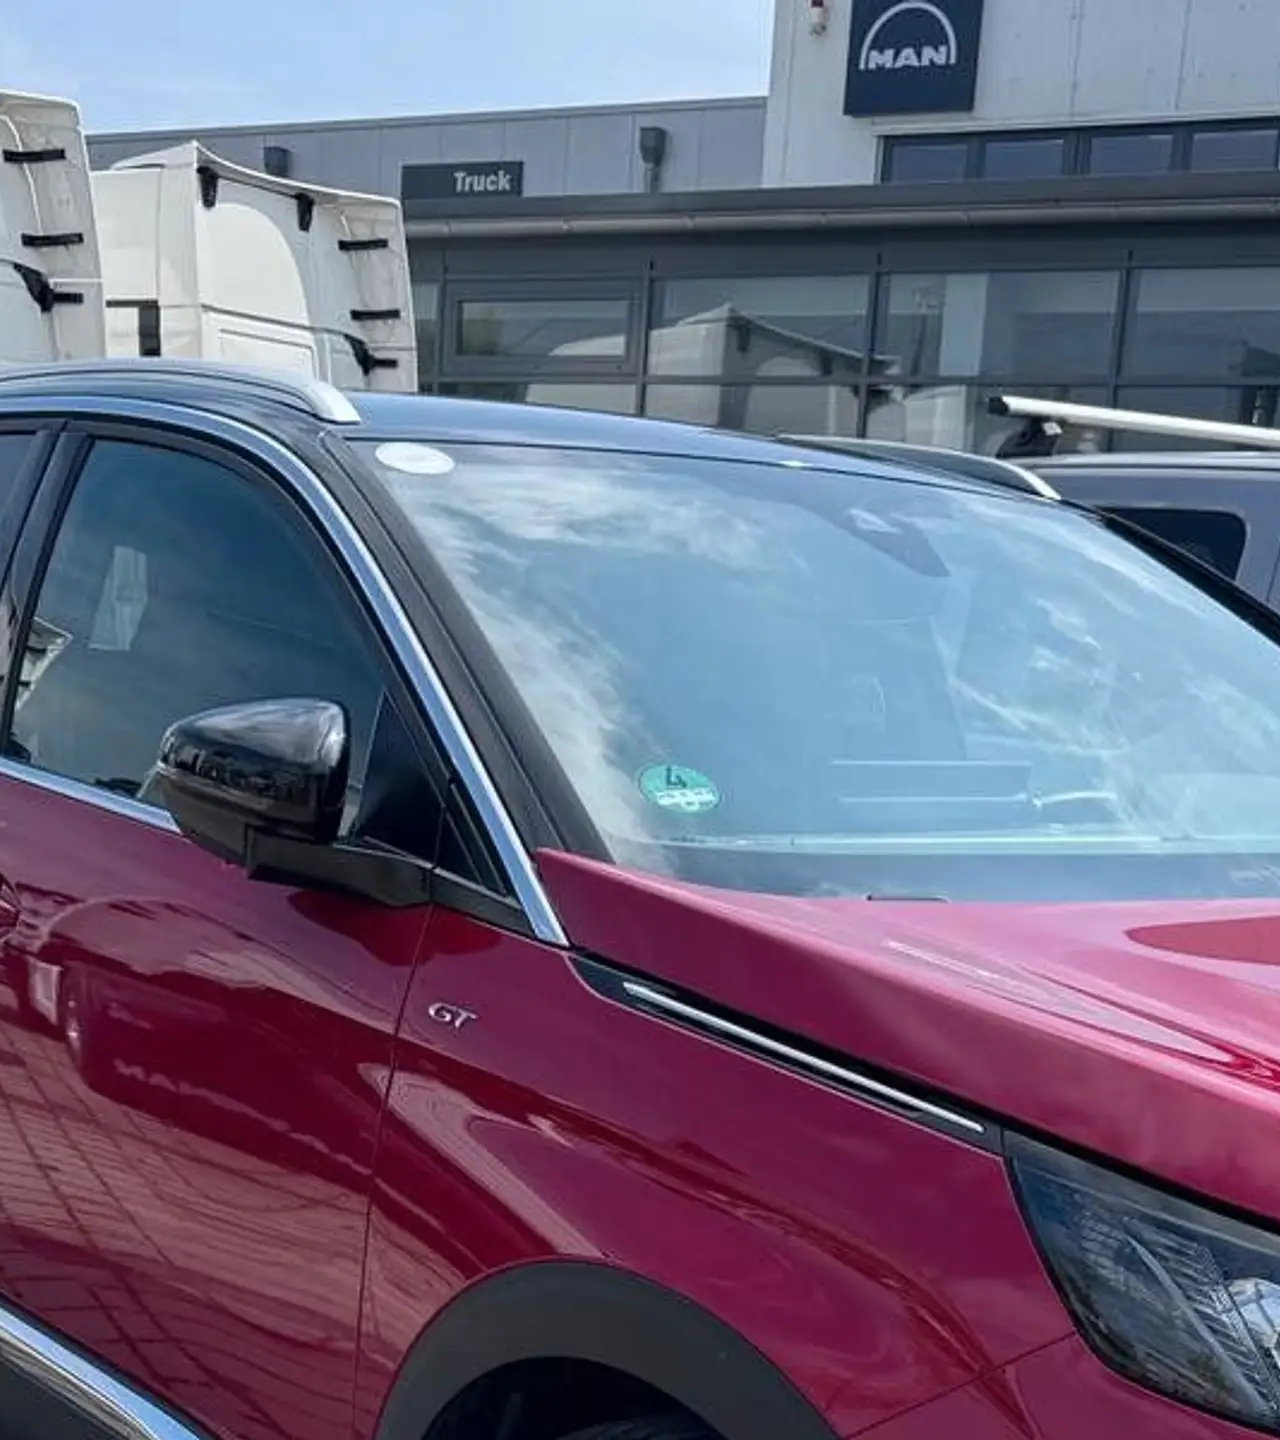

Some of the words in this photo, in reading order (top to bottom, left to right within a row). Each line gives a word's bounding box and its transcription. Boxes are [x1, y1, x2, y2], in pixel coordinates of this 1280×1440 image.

[867, 44, 949, 70] MAN
[453, 169, 512, 193] Truck
[428, 1002, 479, 1028] GT
